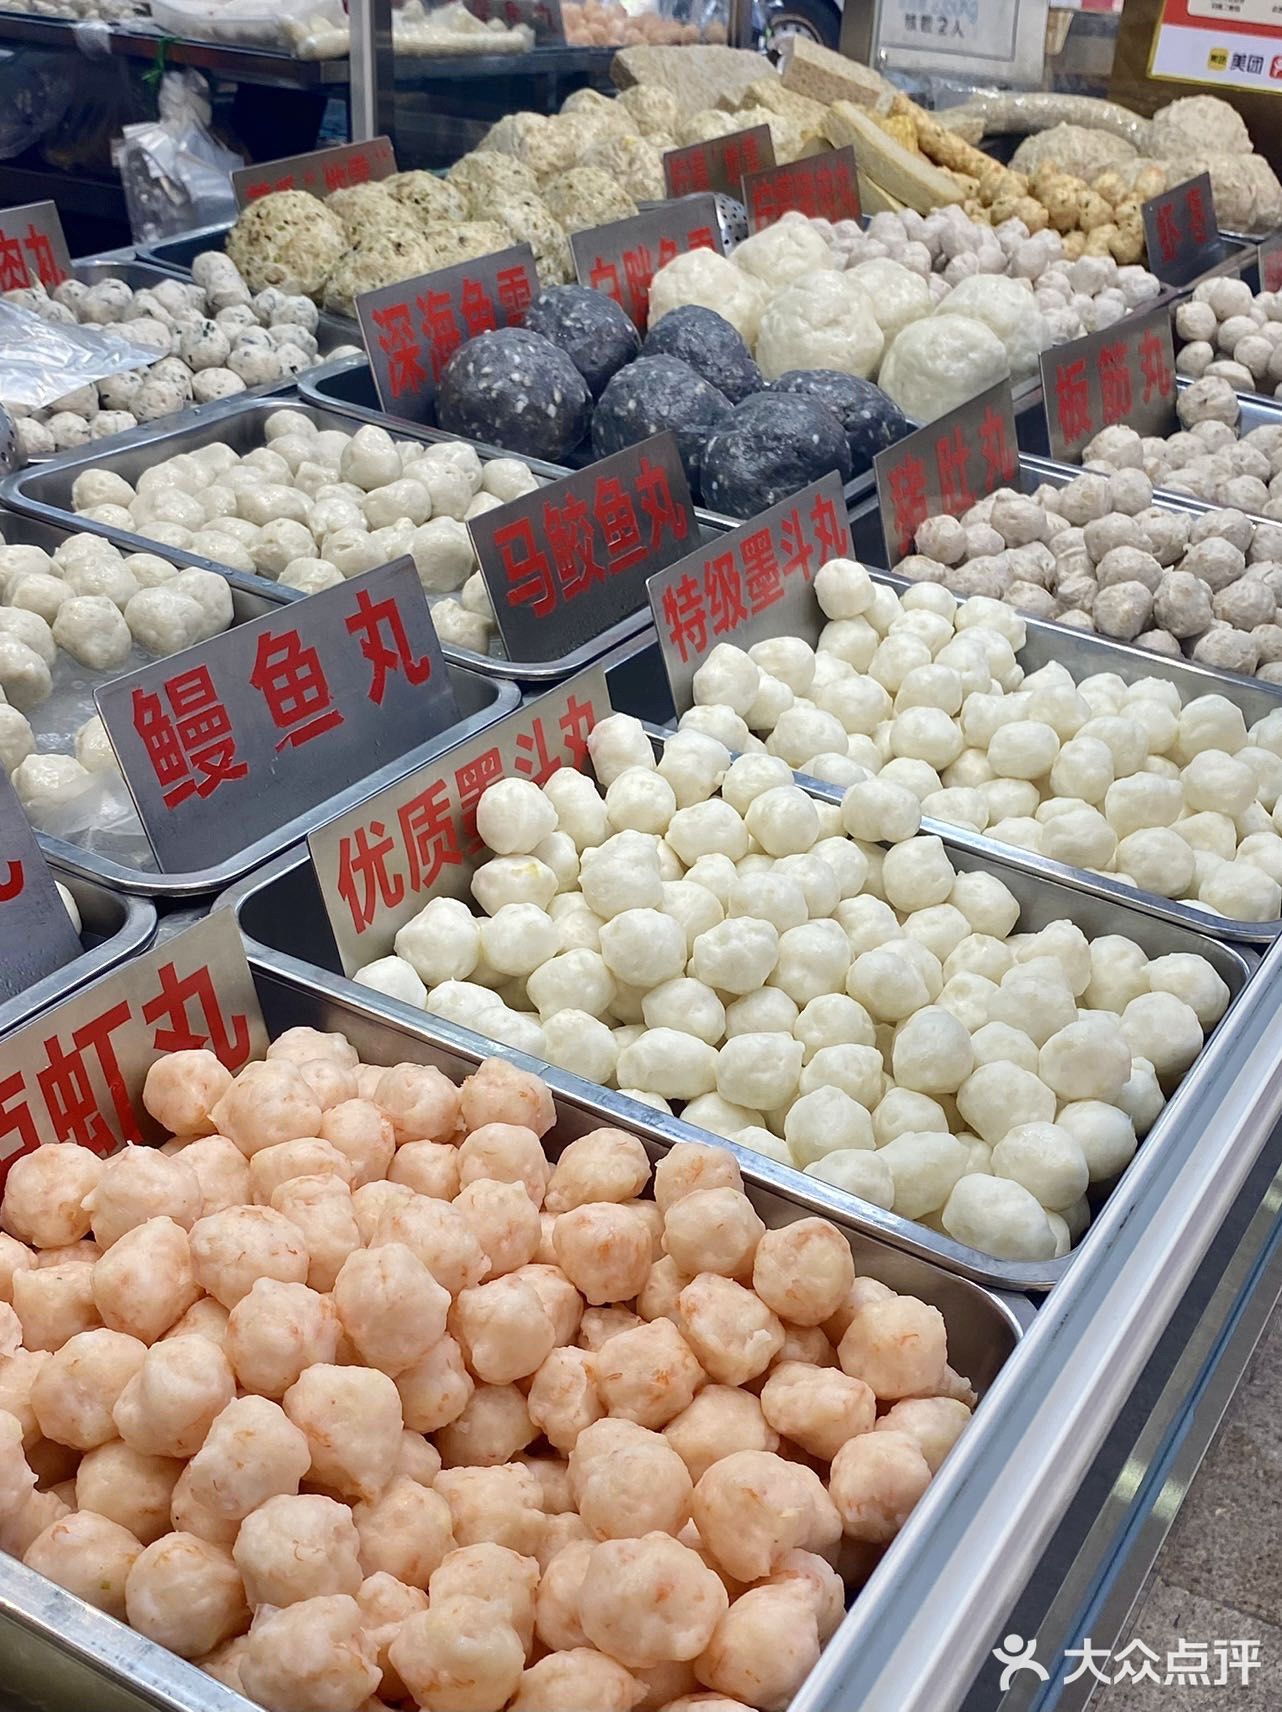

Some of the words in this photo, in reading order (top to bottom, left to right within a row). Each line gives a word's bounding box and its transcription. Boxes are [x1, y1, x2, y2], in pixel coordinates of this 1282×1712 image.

[1230, 52, 1264, 75] 美团
[1056, 328, 1173, 446] 板筋丸
[493, 457, 688, 619] 马鲛鱼丸
[661, 493, 848, 663] 特级墨斗丸
[130, 589, 432, 811] 鳗鱼丸
[336, 694, 598, 935] 优质墨斗丸
